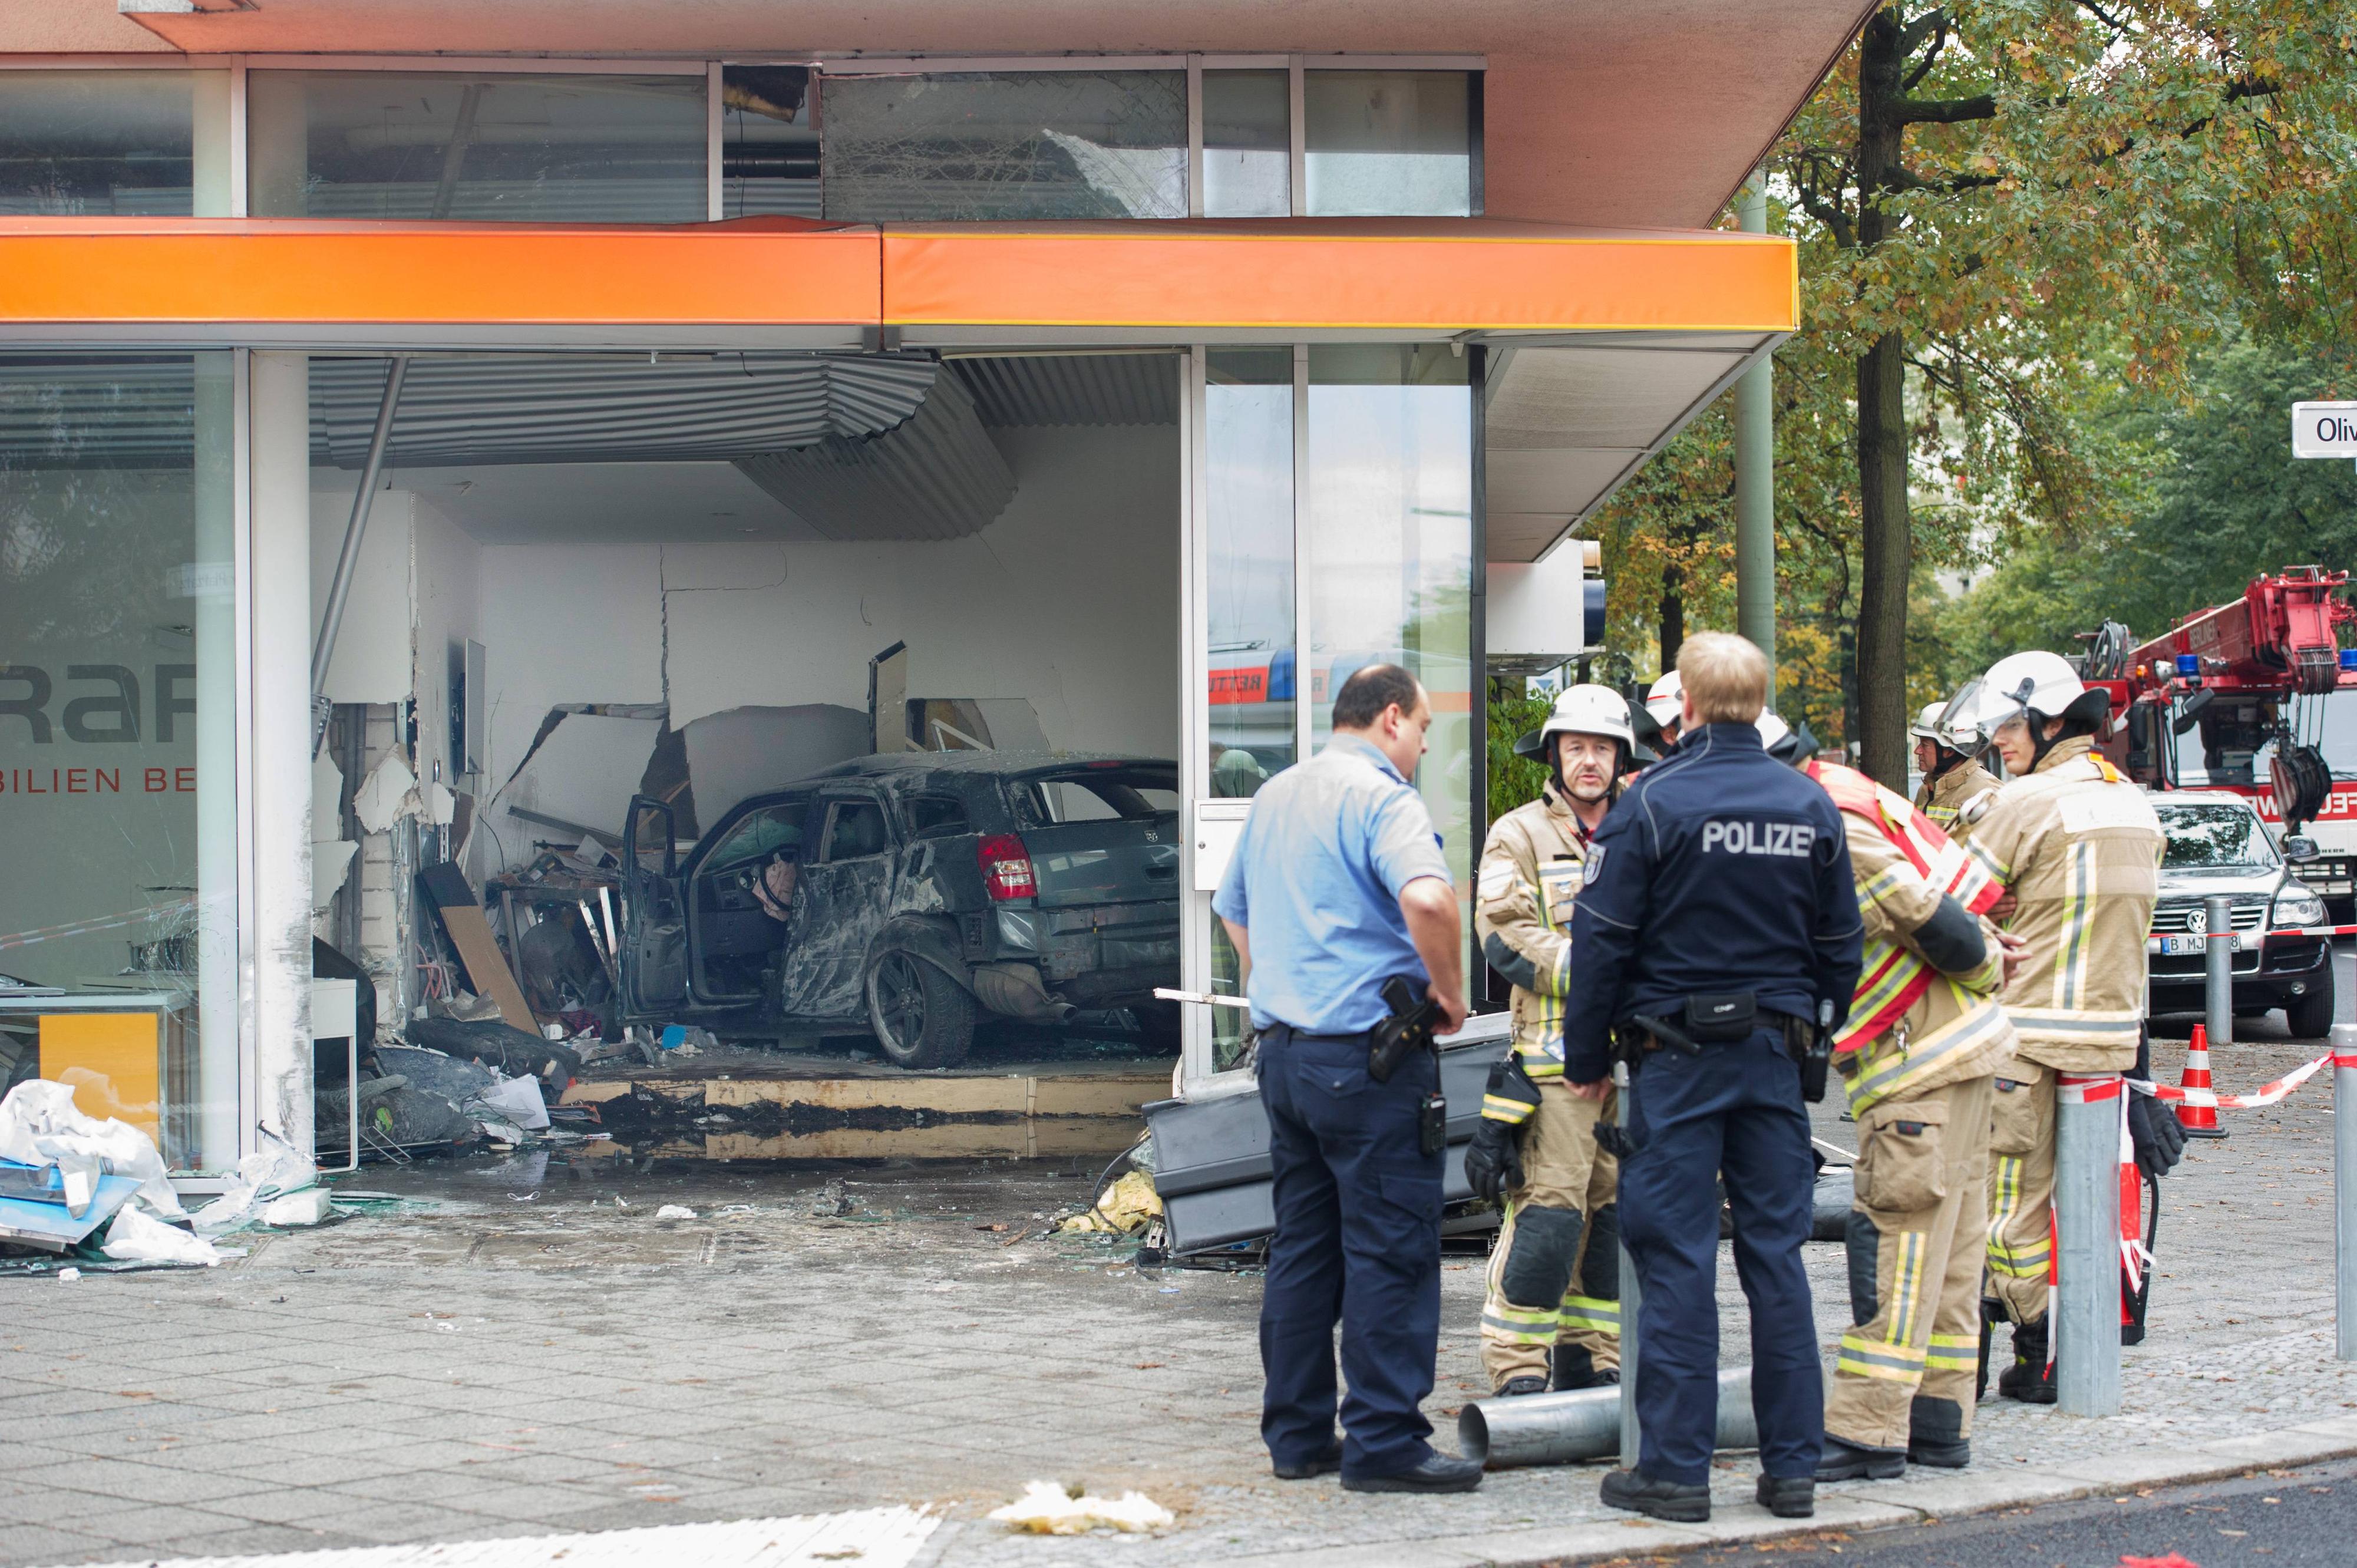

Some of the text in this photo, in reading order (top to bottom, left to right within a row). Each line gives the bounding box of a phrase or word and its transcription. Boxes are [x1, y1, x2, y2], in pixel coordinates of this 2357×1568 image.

[2316, 417, 2357, 442] Oliv
[0, 767, 196, 794] ILIEN BE
[2171, 939, 2179, 951] B
[2187, 938, 2204, 950] MJ
